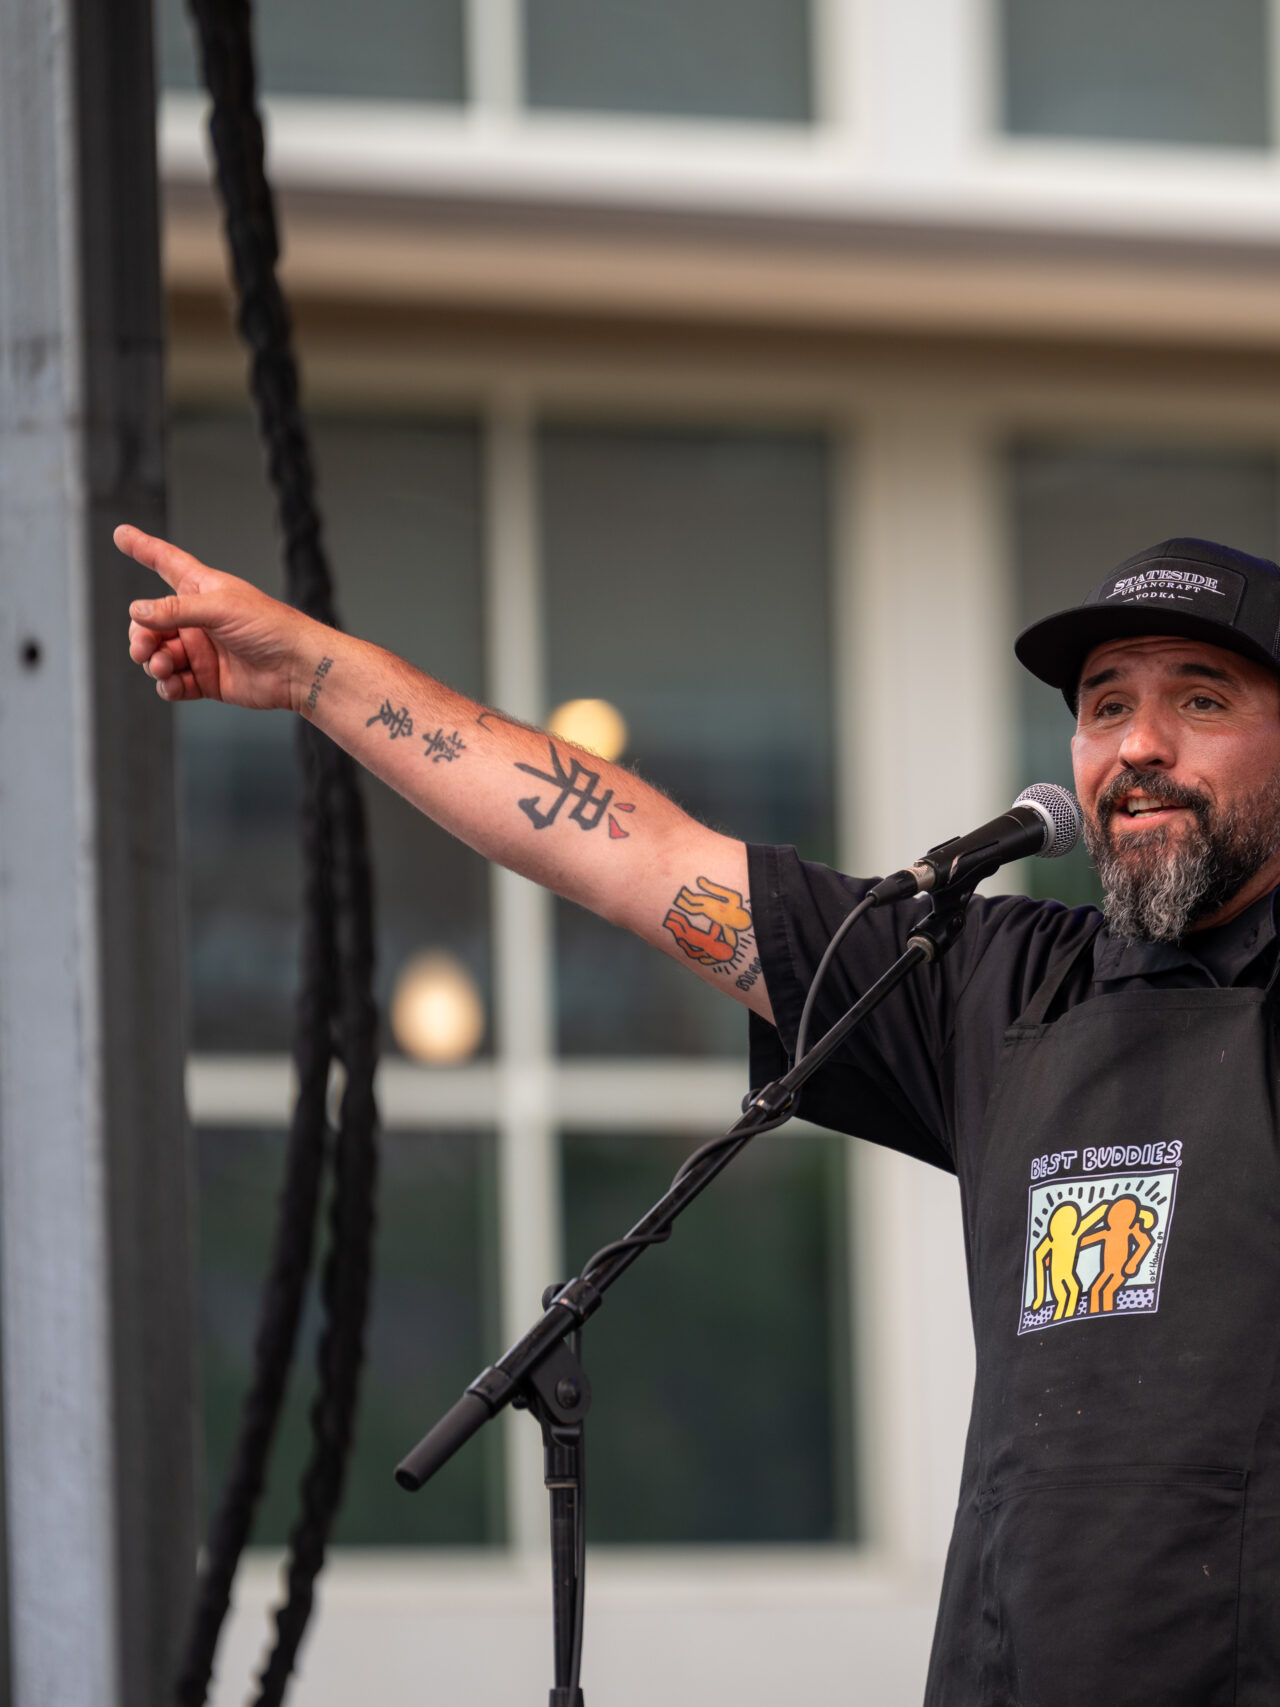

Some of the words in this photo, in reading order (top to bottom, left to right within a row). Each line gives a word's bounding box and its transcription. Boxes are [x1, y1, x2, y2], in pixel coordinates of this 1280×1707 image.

[1113, 569, 1219, 592] STATESIDE
[1121, 581, 1201, 596] URBANCRAFT
[1135, 591, 1176, 600] VODKA
[1030, 1150, 1078, 1180] BEST
[1082, 1139, 1183, 1171] BUDDIES
